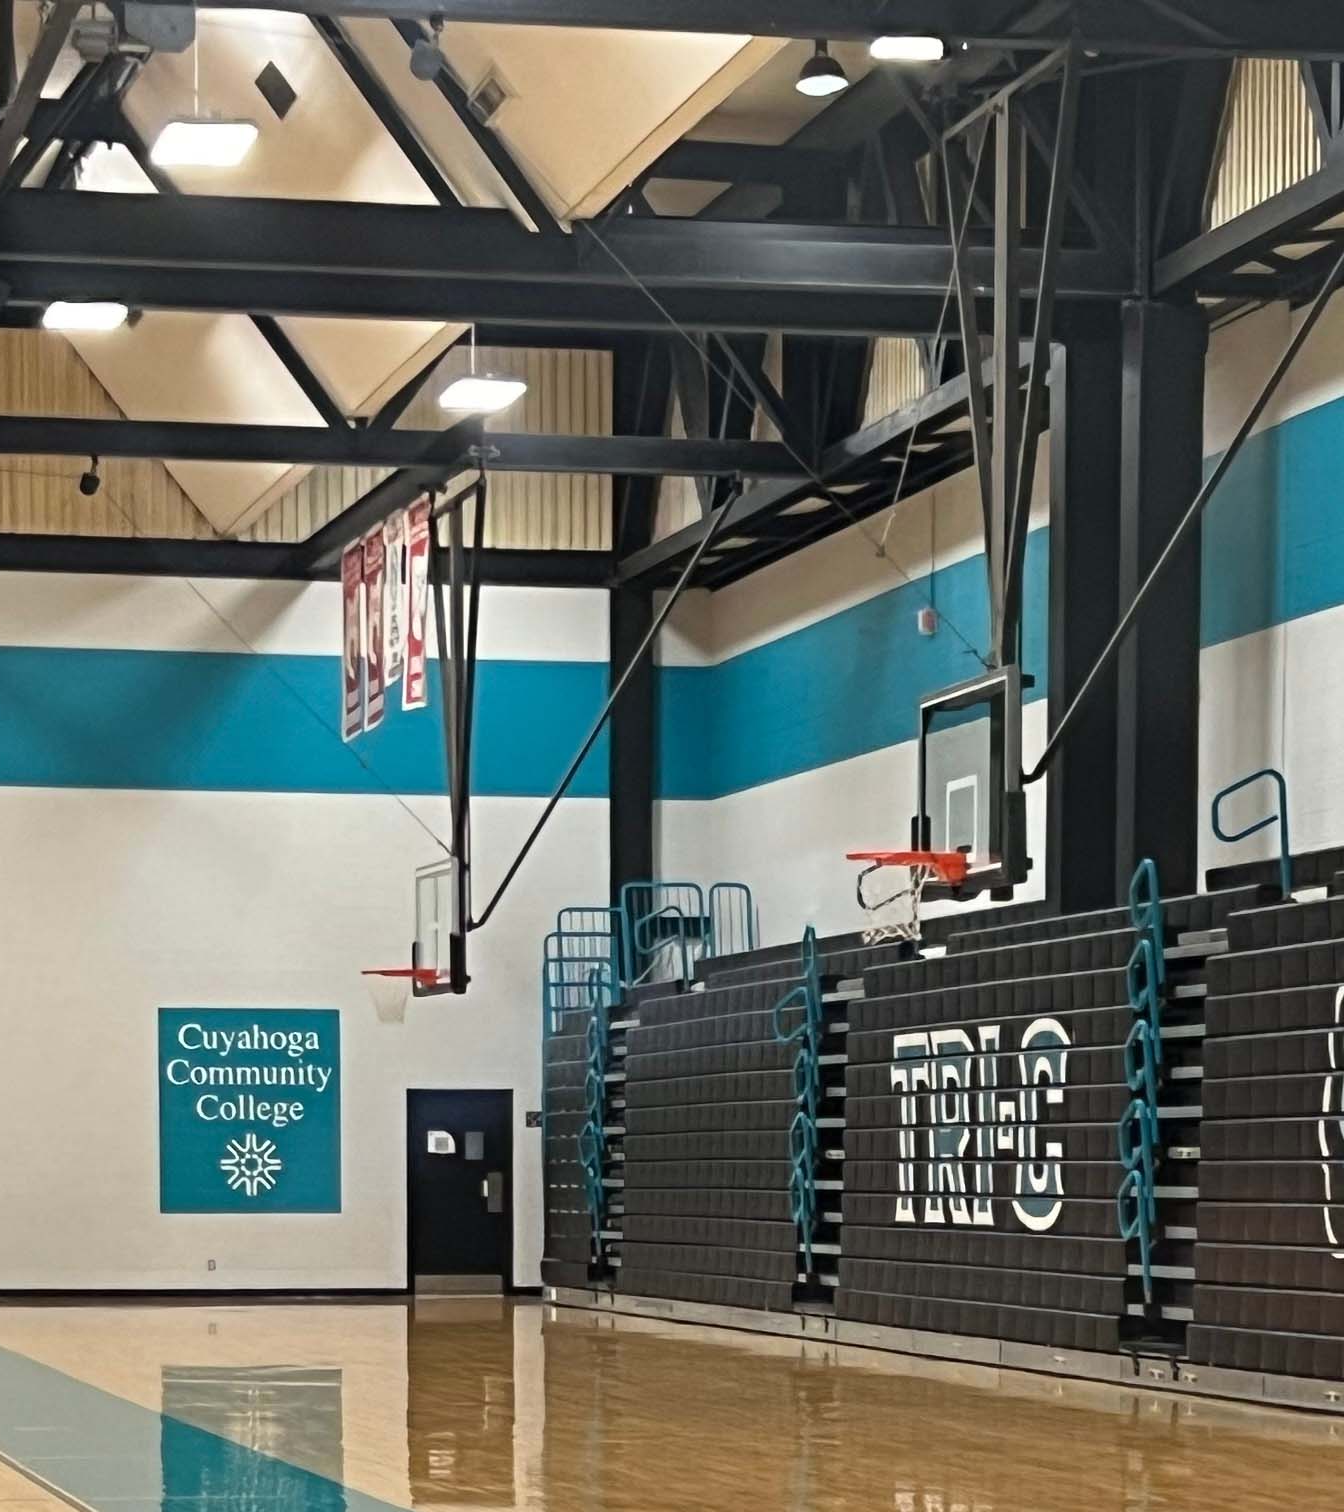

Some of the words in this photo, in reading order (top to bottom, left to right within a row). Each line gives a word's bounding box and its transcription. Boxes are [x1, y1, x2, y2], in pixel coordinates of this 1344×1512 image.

[178, 1023, 320, 1057] Cuyahoga
[166, 1059, 332, 1092] Community
[196, 1094, 304, 1127] College
[890, 1017, 1072, 1232] TRI-C
